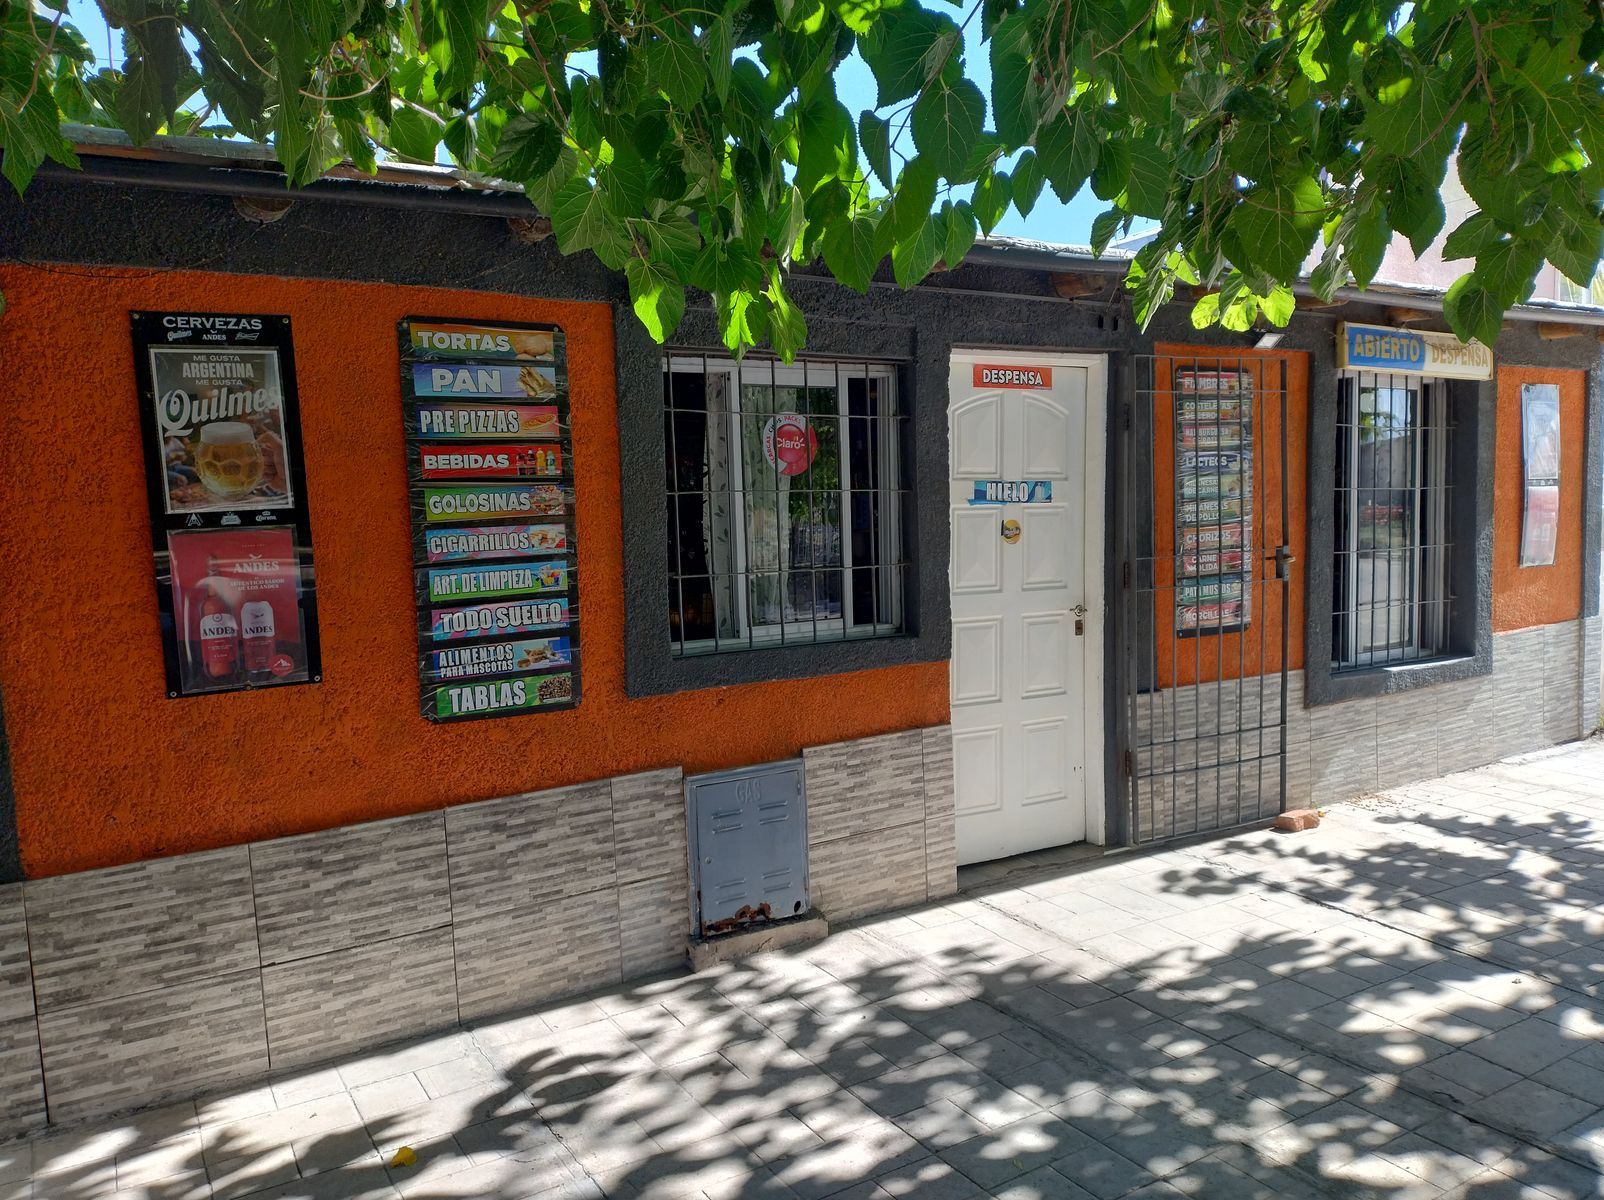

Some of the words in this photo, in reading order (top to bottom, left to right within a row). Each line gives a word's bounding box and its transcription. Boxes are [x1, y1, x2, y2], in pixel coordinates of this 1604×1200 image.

[162, 316, 263, 330] CERVEZAS
[417, 331, 512, 352] TORTAS
[1353, 333, 1421, 362] ABIERTO
[1431, 343, 1489, 368] DESPENSA
[182, 363, 254, 378] ARGENTINA
[431, 368, 502, 393] PAN
[982, 369, 1044, 386] DESPENSA
[1184, 377, 1228, 389] FIMBRES
[419, 409, 455, 434] PRE
[458, 409, 520, 434] PIZZAS
[423, 454, 510, 470] BEBIDAS
[986, 482, 1029, 502] HIELO
[428, 492, 532, 515] GOLOSINAS
[430, 532, 530, 554] CIGARRILLOS
[233, 561, 280, 574] ANDES
[433, 575, 460, 596] ART.
[462, 573, 477, 593] DE
[480, 569, 533, 592] LIMPIEZA
[440, 607, 493, 633] TODO
[495, 602, 563, 629] SUELTO
[244, 625, 273, 634] ANDES
[439, 643, 514, 668] ALIMENTOS
[440, 664, 464, 679] PARA
[465, 659, 514, 676] MASCOTAS
[448, 680, 527, 714] TABLAS
